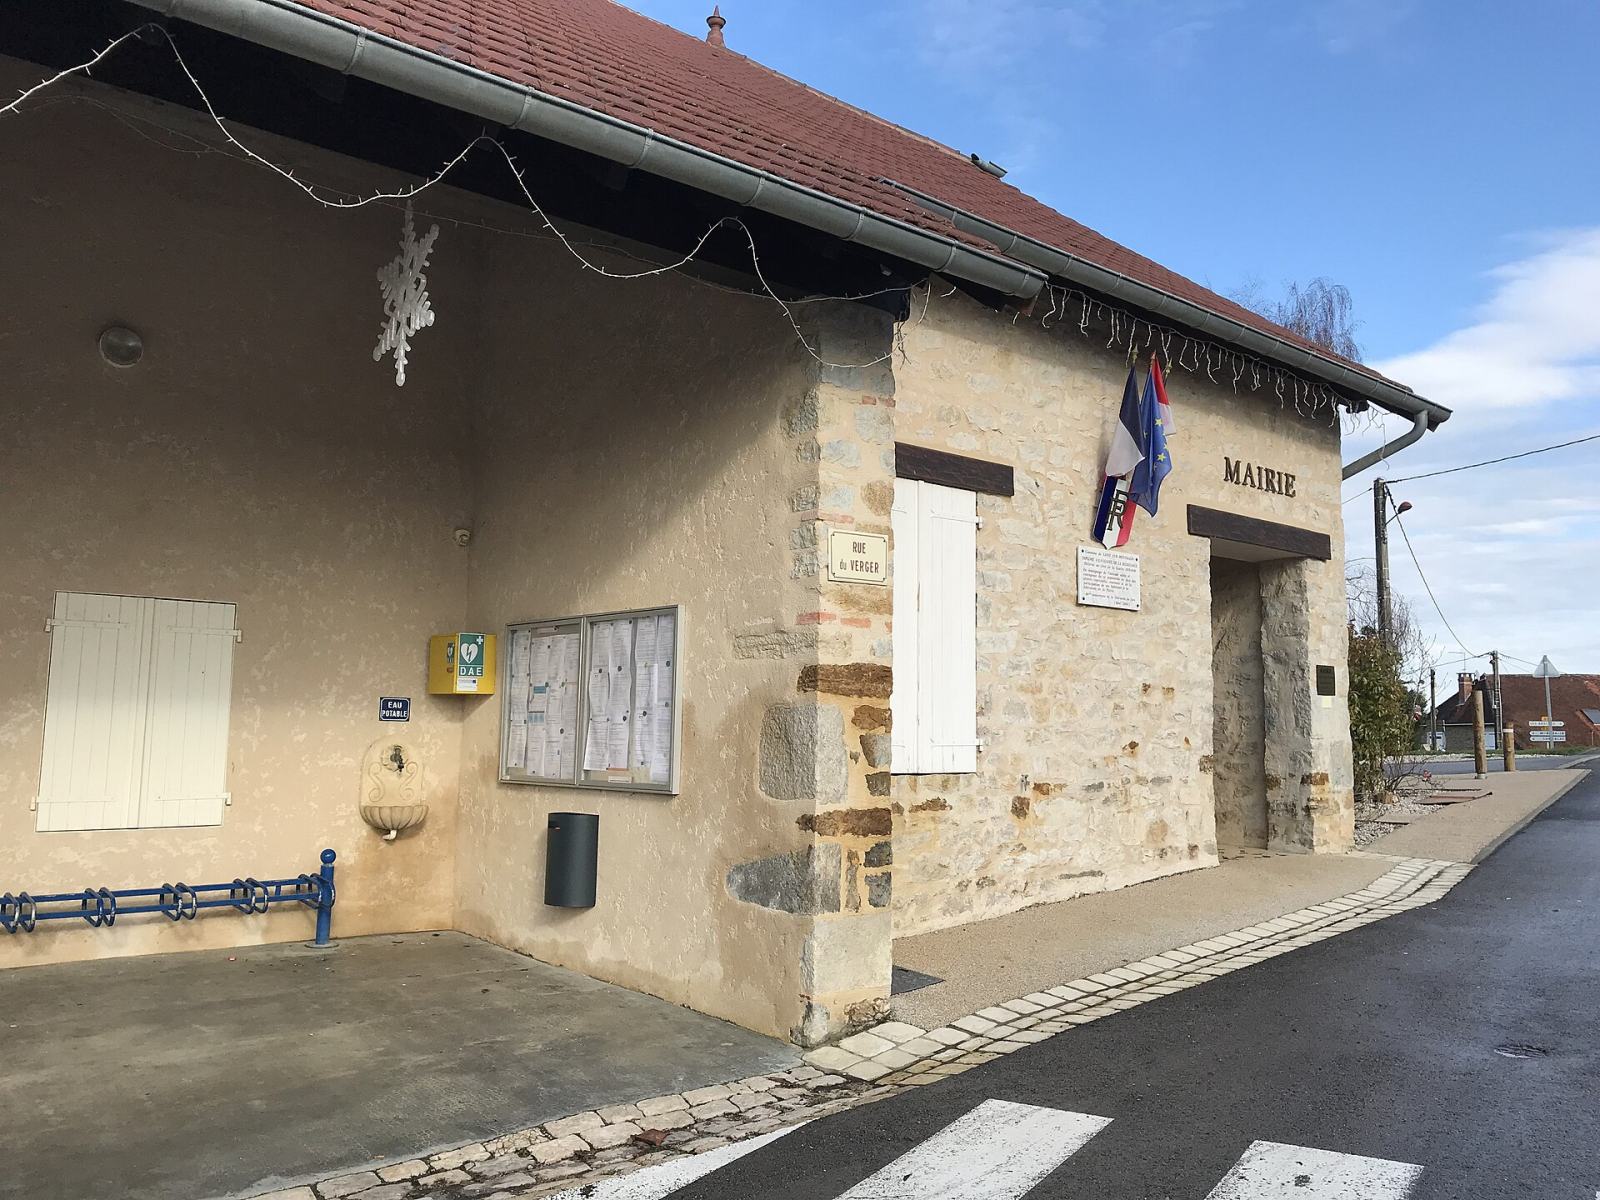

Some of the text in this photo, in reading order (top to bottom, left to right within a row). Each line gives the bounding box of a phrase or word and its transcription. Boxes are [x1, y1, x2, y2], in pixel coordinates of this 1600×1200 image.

[1223, 456, 1297, 498] MAIRIE
[852, 541, 866, 554] RUE
[840, 559, 879, 573] du VERGER
[459, 666, 483, 676] DAE
[387, 701, 403, 709] EAU
[382, 710, 408, 718] POTABLE
